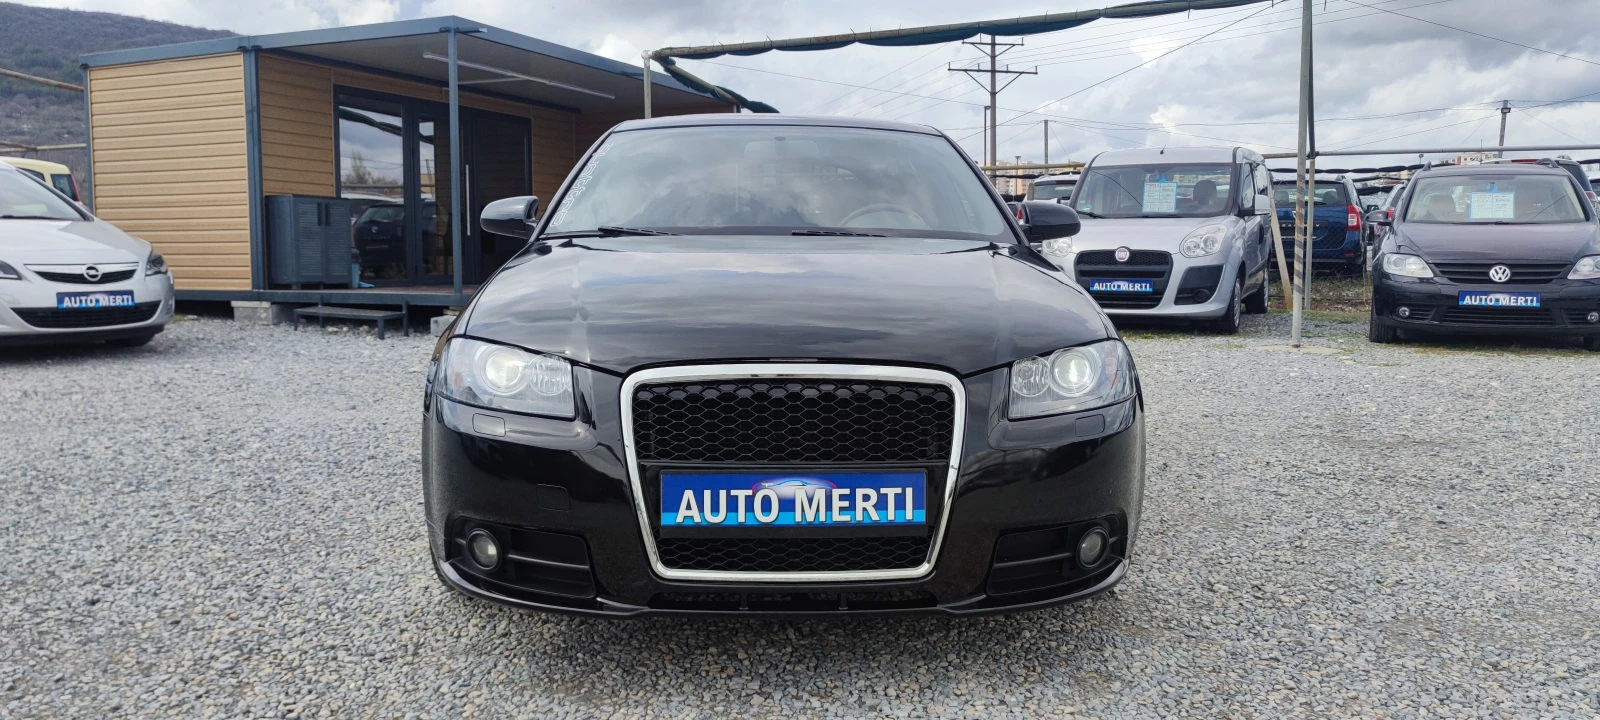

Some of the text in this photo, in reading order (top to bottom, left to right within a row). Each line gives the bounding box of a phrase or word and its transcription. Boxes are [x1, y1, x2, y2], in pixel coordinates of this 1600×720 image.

[1093, 282, 1150, 292] AUTO MERTI
[63, 294, 132, 308] AUTO MERTI
[1463, 295, 1537, 306] AUTO MERTI
[675, 487, 914, 523] AUTO MERTI
